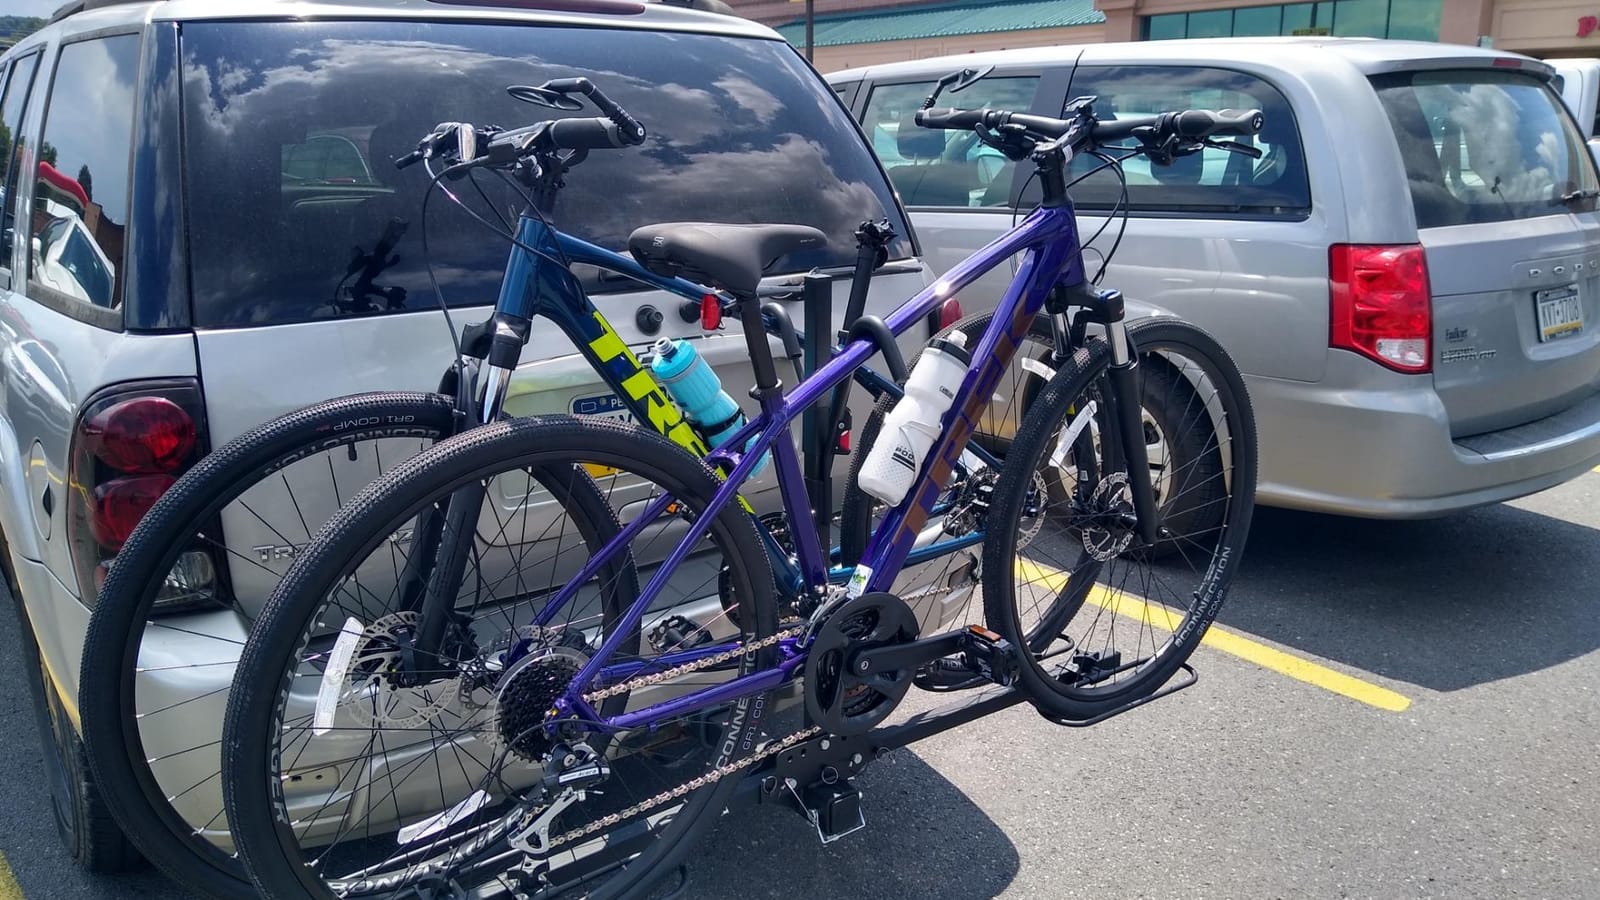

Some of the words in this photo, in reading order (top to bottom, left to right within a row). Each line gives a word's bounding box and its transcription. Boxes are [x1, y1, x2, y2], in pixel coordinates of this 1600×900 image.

[333, 416, 380, 431] COMP
[890, 288, 1038, 546] TREK
[1180, 547, 1231, 640] CONNECTION
